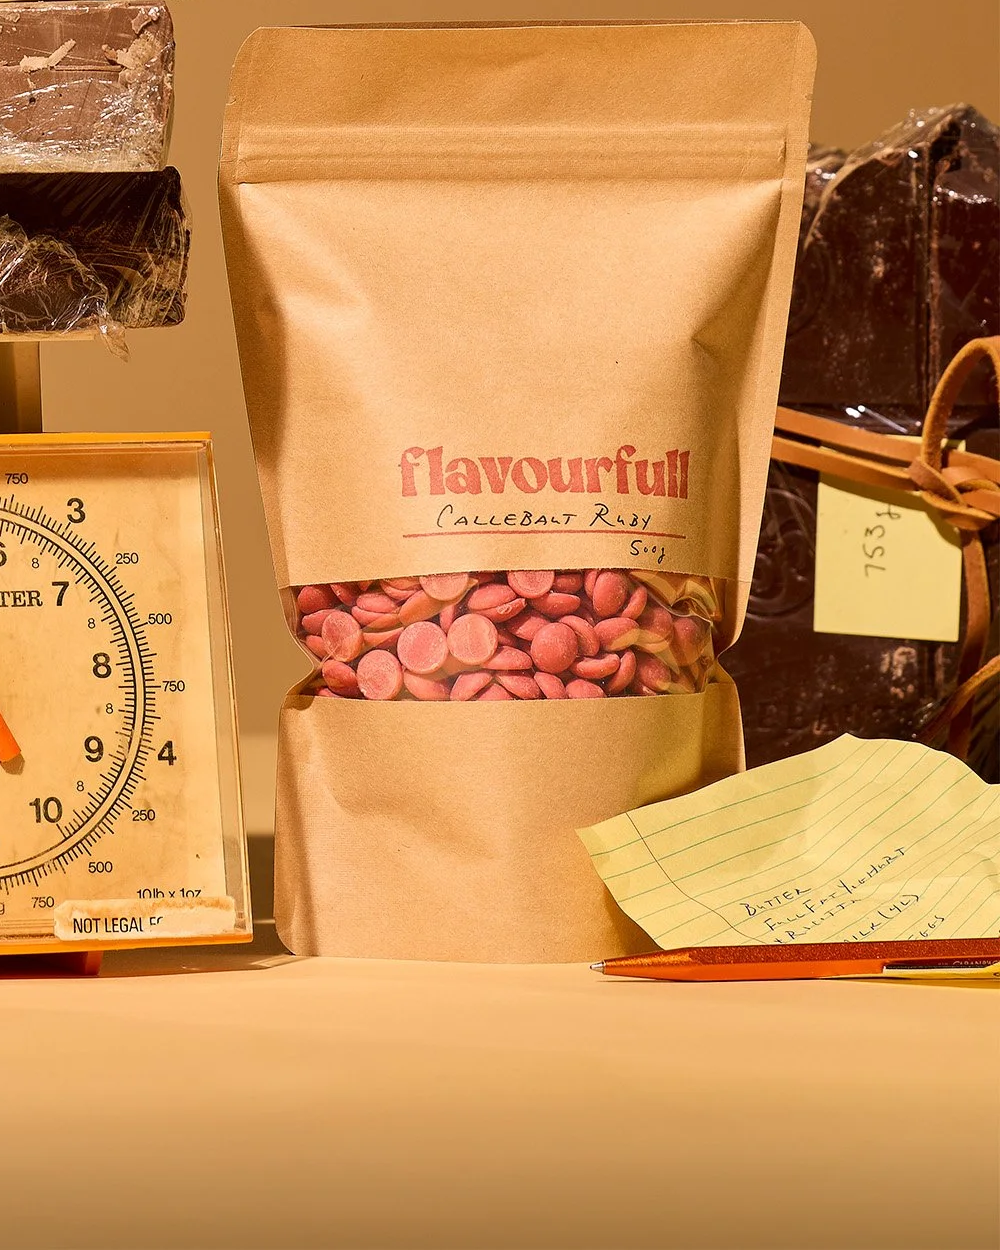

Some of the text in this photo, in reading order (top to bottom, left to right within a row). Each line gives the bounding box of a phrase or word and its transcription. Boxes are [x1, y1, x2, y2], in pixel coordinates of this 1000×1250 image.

[398, 444, 690, 499] flavourfull
[5, 473, 29, 485] 750
[67, 498, 86, 524] 3
[862, 505, 901, 578] 753g
[31, 558, 40, 569] 8
[115, 553, 139, 565] 250
[51, 581, 70, 607] 7
[87, 617, 96, 629] 8
[148, 613, 172, 625] 500
[92, 652, 112, 679] 8
[162, 680, 186, 692] 750
[105, 703, 114, 714] 8
[84, 736, 104, 763] 9
[157, 740, 177, 766] 4
[76, 780, 85, 792] 8
[29, 796, 63, 824] 10
[131, 809, 156, 822] 250
[88, 861, 113, 873] 500
[31, 896, 55, 909] 750
[72, 917, 101, 934] NOT
